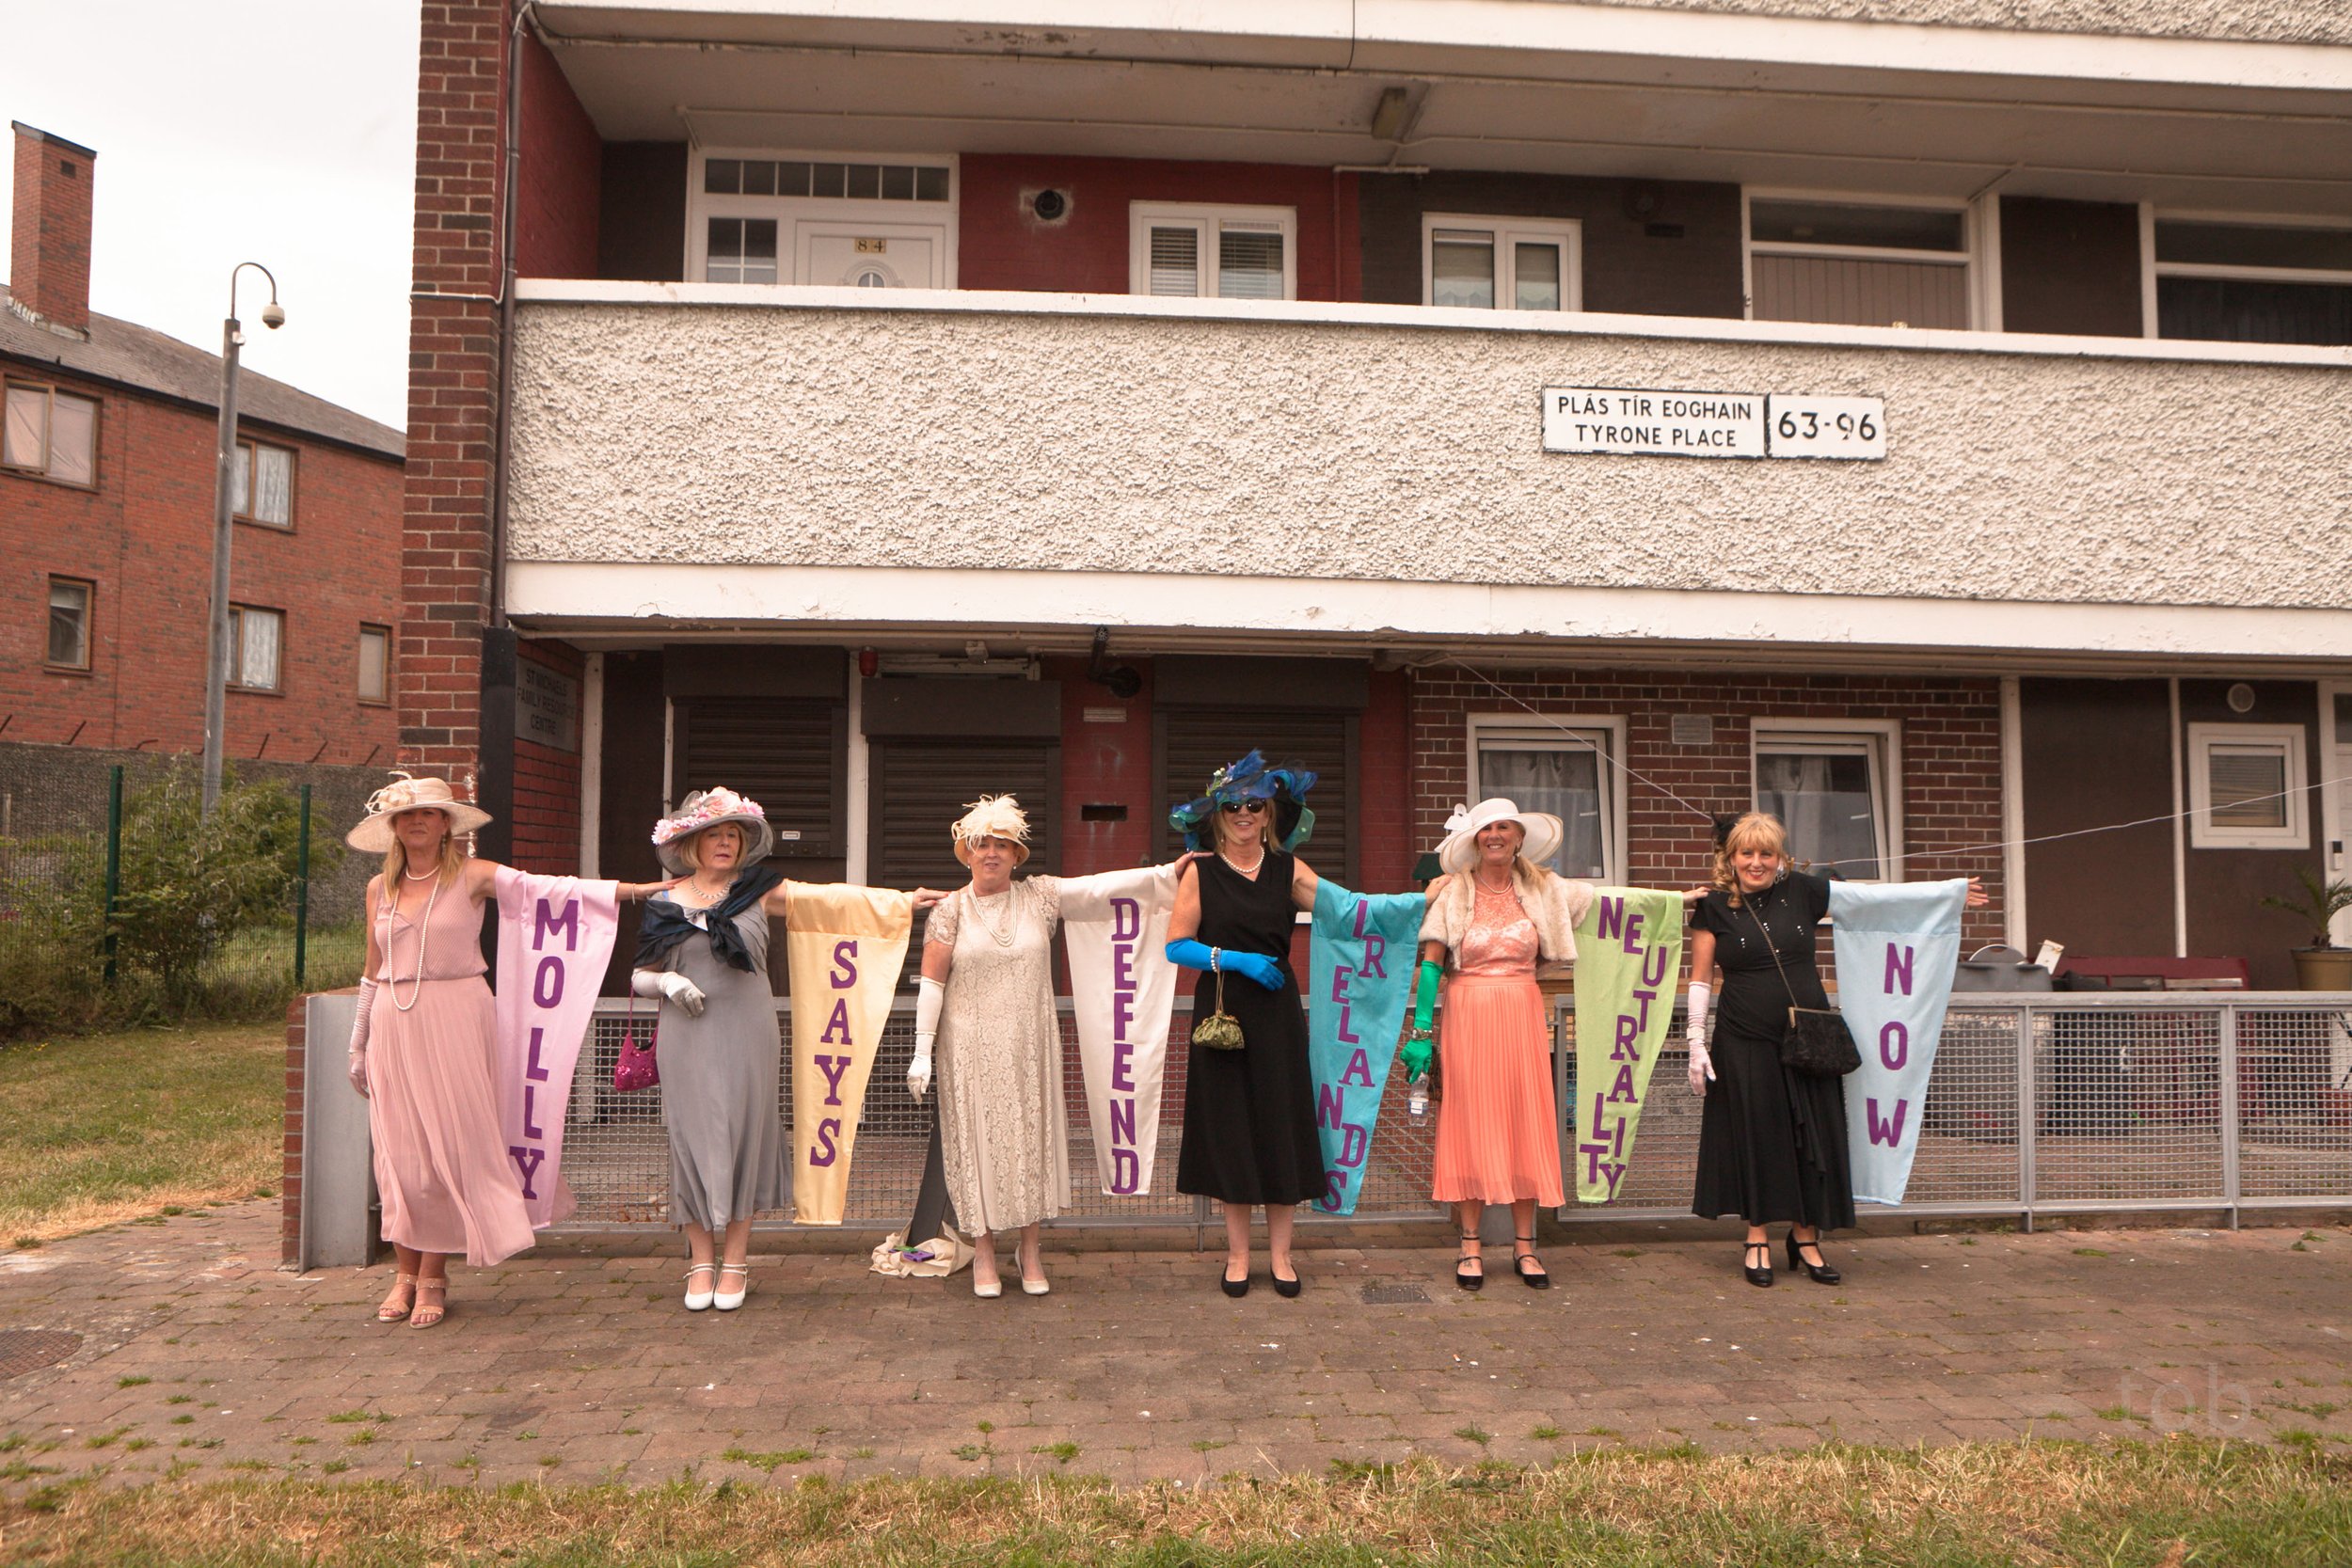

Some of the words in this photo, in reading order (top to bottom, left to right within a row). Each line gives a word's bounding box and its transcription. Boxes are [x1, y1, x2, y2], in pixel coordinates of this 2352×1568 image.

[857, 239, 883, 253] 84
[1558, 393, 1609, 415] PLÁS
[1619, 395, 1653, 417] TÍR
[1662, 400, 1752, 420] EOGHAIN
[1575, 424, 1662, 445] TYRONE
[1672, 428, 1737, 447] PLACE
[1777, 410, 1877, 441] 63-96
[516, 686, 541, 708] FAMILY
[530, 714, 557, 736] CENTRE
[509, 898, 579, 1199] MOLLY
[809, 941, 858, 1167] SAYS
[1110, 897, 1140, 1195] DEFEND
[1318, 899, 1388, 1212] IRELANDS
[1579, 895, 1666, 1203] NEUTRALITY
[1866, 942, 1914, 1148] NOW
